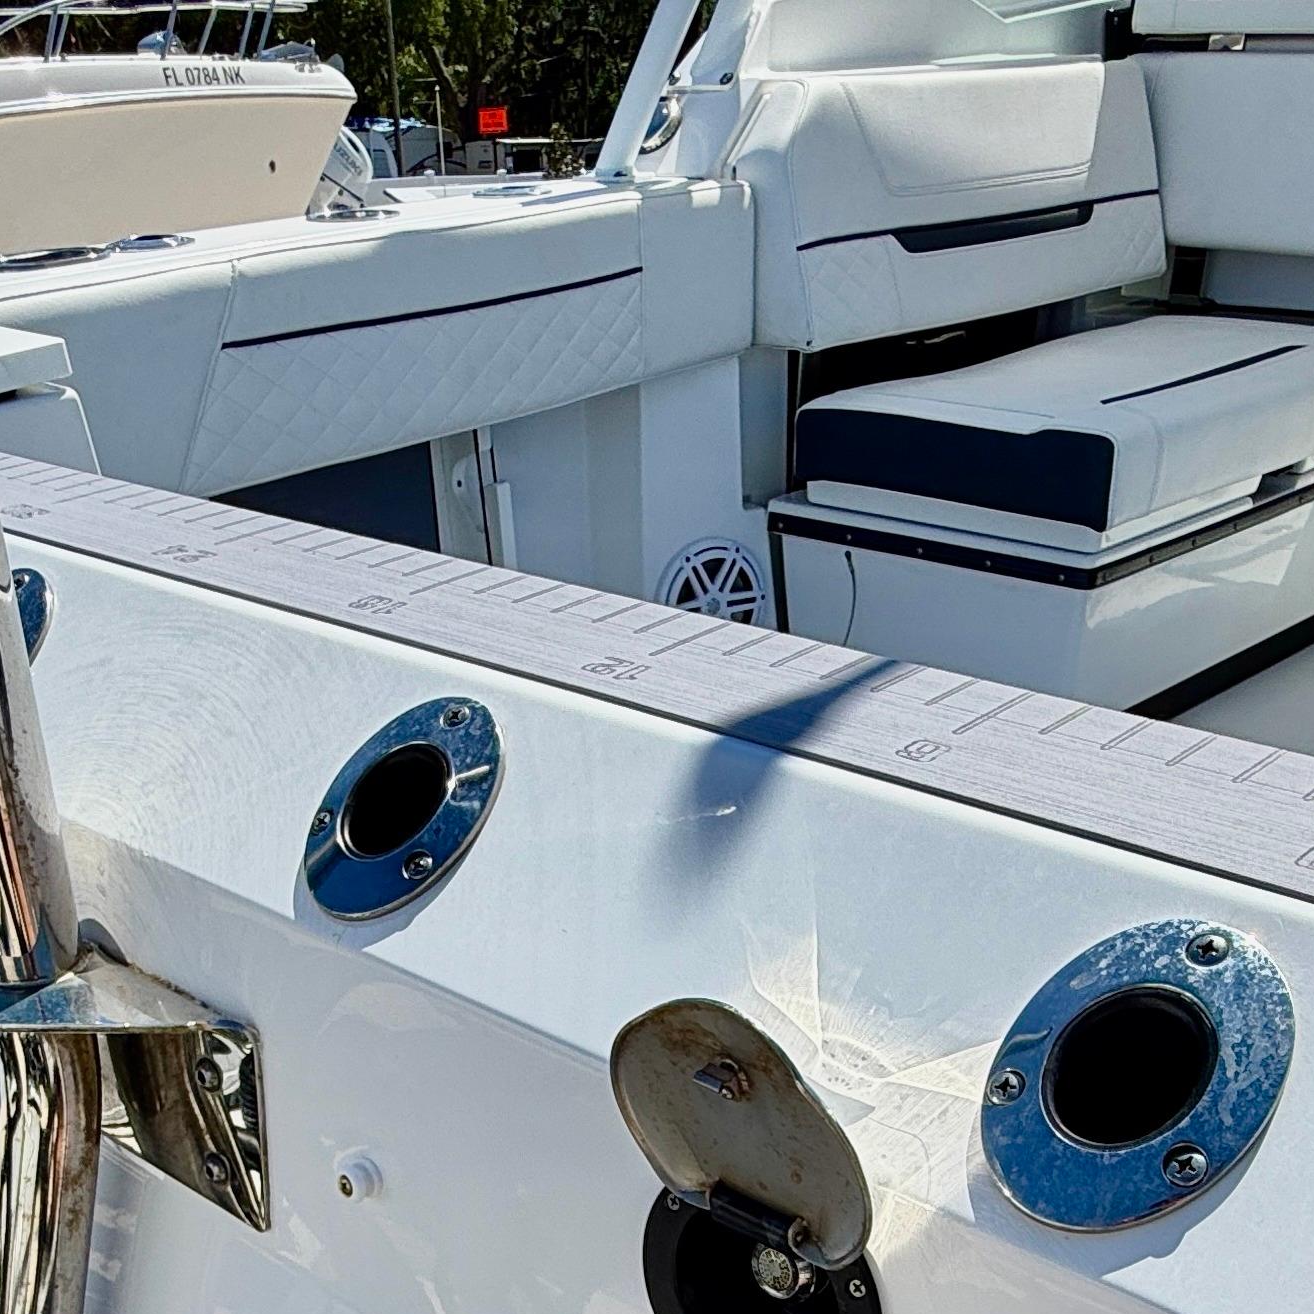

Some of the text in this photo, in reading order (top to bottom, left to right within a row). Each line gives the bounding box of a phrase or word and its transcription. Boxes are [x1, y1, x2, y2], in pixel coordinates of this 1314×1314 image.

[162, 66, 246, 87] FL 0784 NK
[581, 656, 652, 680] 12
